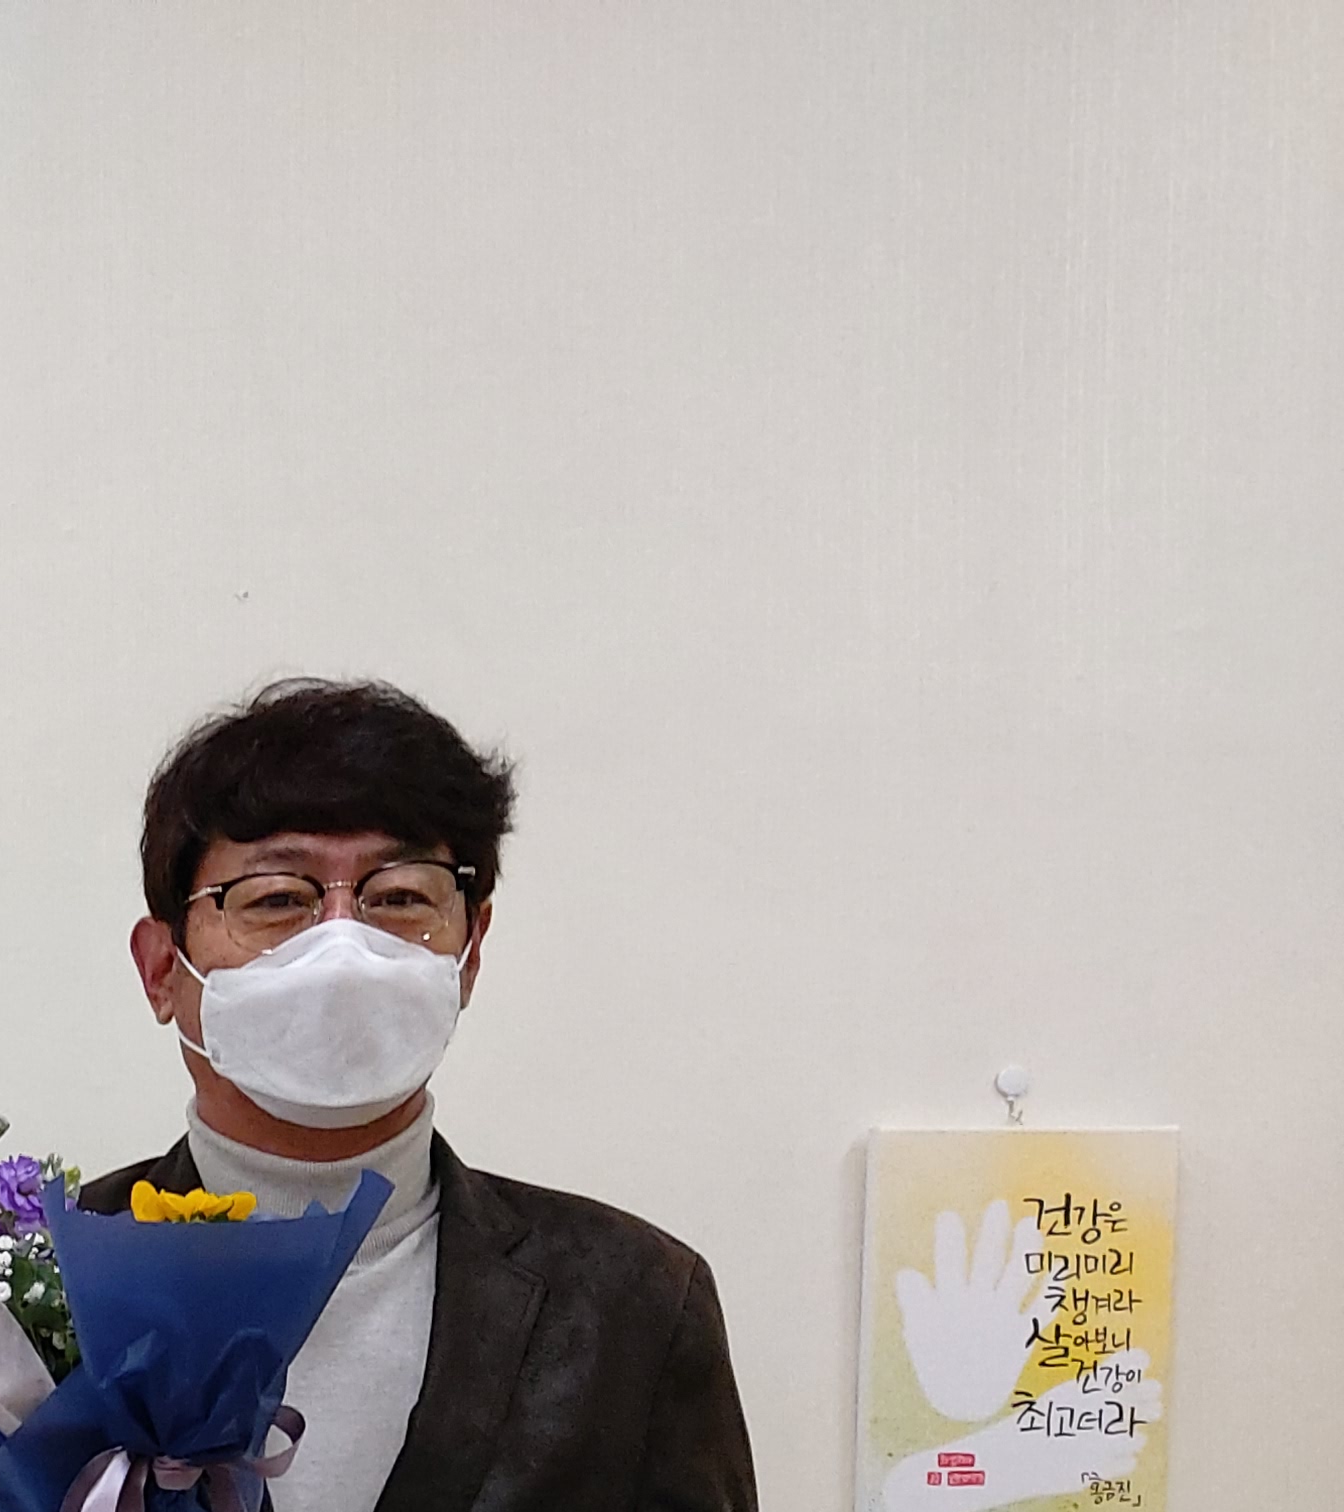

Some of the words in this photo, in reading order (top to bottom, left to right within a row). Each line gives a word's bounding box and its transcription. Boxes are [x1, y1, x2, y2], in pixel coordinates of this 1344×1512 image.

[1023, 1192, 1128, 1245] 건강은
[1024, 1248, 1134, 1281] 미리미리
[1044, 1286, 1143, 1325] 챙겨라
[1025, 1317, 1131, 1367] 살아보니
[1071, 1358, 1142, 1394] 건강이
[1011, 1390, 1149, 1438] 최고더라
